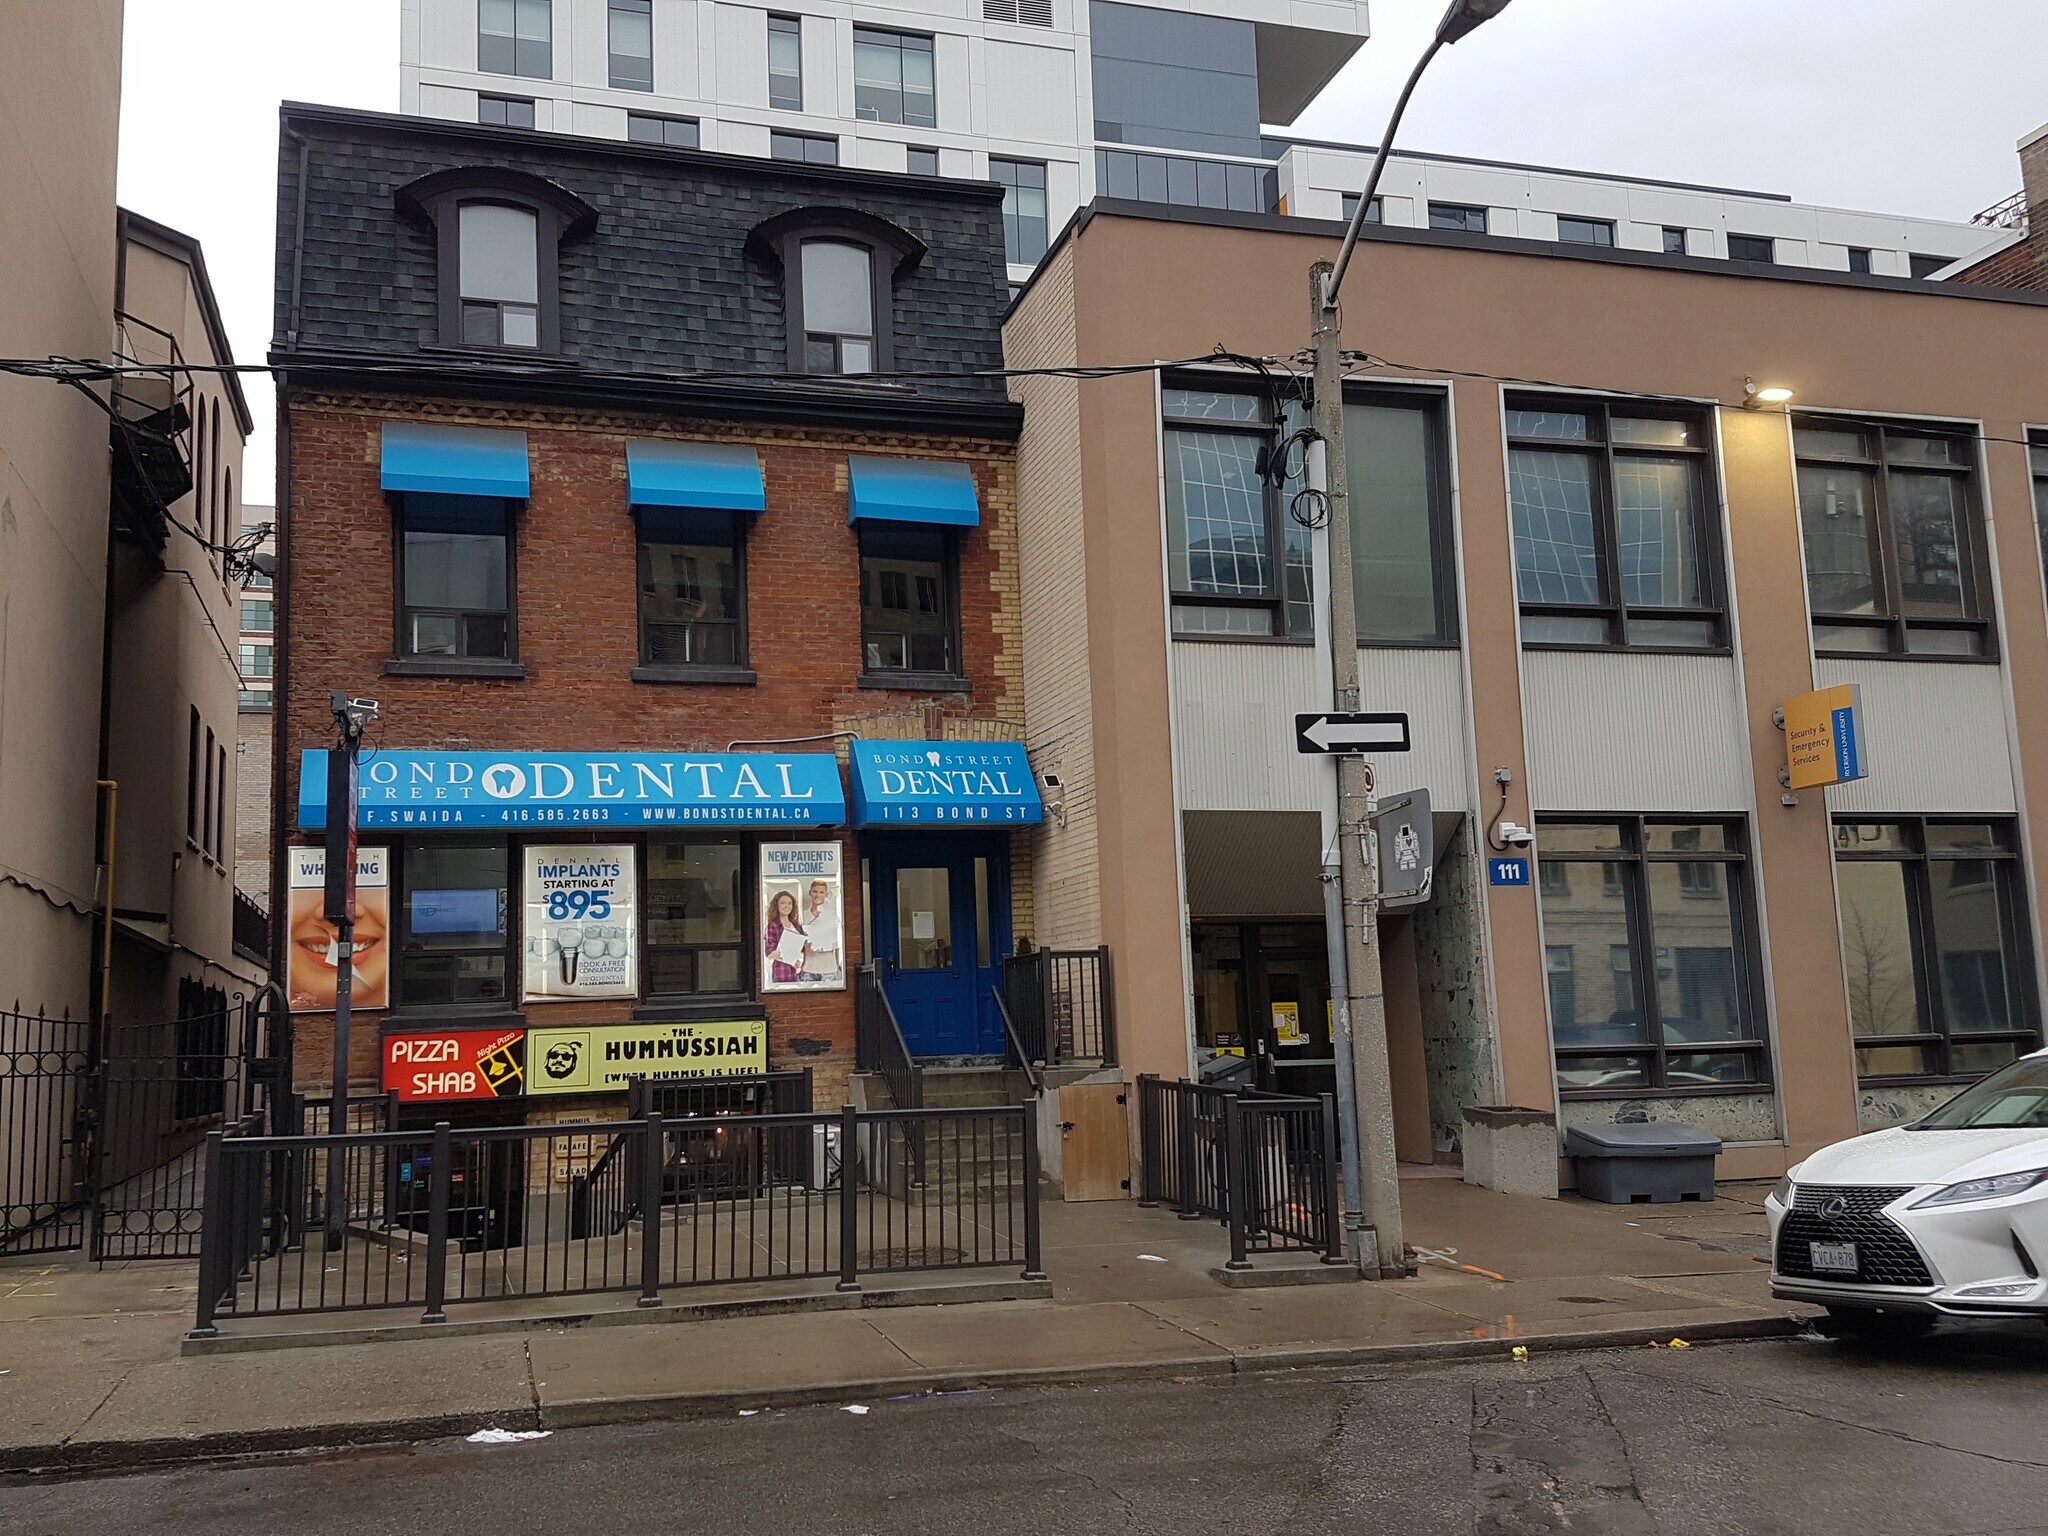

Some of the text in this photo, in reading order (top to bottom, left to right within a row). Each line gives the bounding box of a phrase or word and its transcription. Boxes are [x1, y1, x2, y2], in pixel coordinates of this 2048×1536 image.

[1790, 723, 1826, 740] Security &
[1839, 711, 1847, 747] UNIVERSITY
[1791, 738, 1830, 753] Emergency
[873, 754, 1013, 765] BOND STREET
[1792, 753, 1820, 767] Services
[370, 761, 474, 784] OND
[528, 762, 814, 799] DENTAL
[877, 770, 1022, 795] DENTAL
[501, 808, 609, 822] 416.585.2663
[643, 807, 811, 820] WWW.BONDSTDENTAL.CA
[883, 806, 1026, 819] 113 BOND ST
[537, 857, 620, 865] DENTAL
[768, 850, 834, 862] NEW PATIENTS
[538, 864, 620, 878] IMPLANTS
[779, 862, 824, 873] WELCOME
[1498, 863, 1520, 880] 111
[543, 879, 615, 889] STARTING AT
[579, 966, 625, 974] CONSULTATION
[672, 1028, 694, 1037] THE
[391, 1039, 459, 1063] PIZZA
[477, 1032, 515, 1058] Night Pizza
[605, 1036, 758, 1061] HUMMUSSIAH
[653, 1069, 705, 1080] HUMMUS
[711, 1068, 723, 1077] IS
[412, 1071, 477, 1095] SHAB
